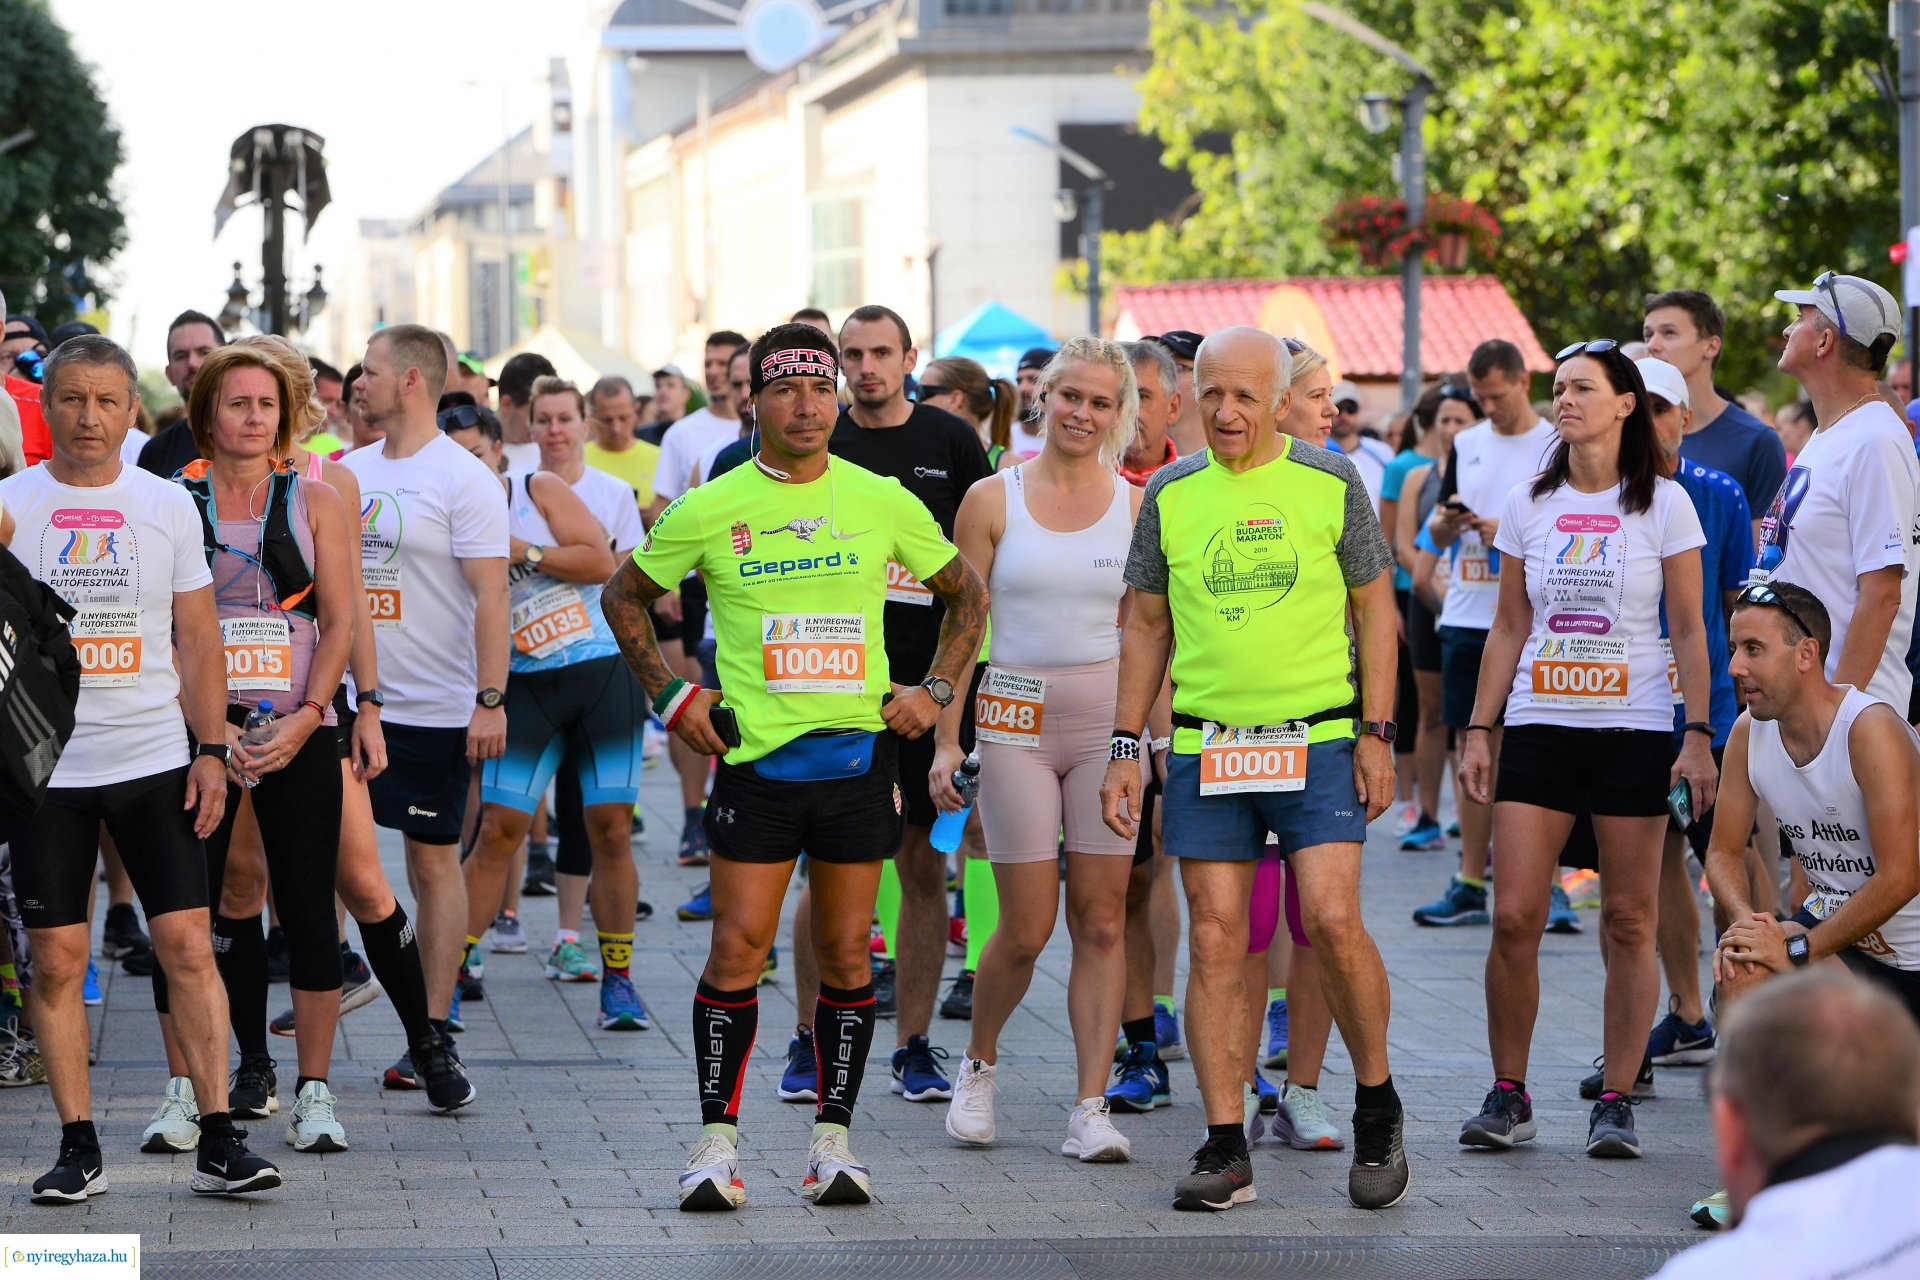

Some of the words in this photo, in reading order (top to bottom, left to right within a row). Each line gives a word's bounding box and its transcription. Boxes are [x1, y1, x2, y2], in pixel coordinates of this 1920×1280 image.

[1236, 526, 1284, 536] BUDAPEST
[1253, 546, 1268, 554] 2019
[740, 551, 841, 577] Gepard
[50, 568, 59, 577] II.
[62, 566, 129, 577] NYÍREGYHÁZI
[886, 561, 928, 590] 02
[1557, 567, 1615, 578] NYÍREGYHÁZI
[50, 577, 130, 587] FUTÓFESZTIVÁL
[1547, 576, 1614, 589] FUTÓFESZTIVÁL
[89, 594, 120, 604] sematic
[1219, 606, 1245, 615] 42,195
[80, 619, 138, 628] FUTÓFESZTIVÁL
[520, 607, 584, 649] 10135
[231, 629, 286, 637] FUTÓFESZTIVÁL
[804, 625, 862, 634] FUTÓFESZTIVÁL
[1569, 646, 1625, 655] FUTÓFESZTIVÁL
[771, 647, 859, 675] 10040
[1540, 665, 1621, 692] 10002
[992, 680, 1042, 694] FUTÓFESZTIVÁL
[1245, 732, 1305, 741] FUTÓFESZTIVÁL
[1211, 750, 1295, 778] 10001
[417, 808, 438, 818] benger
[1776, 817, 1806, 841] iss
[1811, 819, 1861, 841] Attila
[704, 1007, 732, 1094] kalenji
[828, 1010, 863, 1100] kalenji
